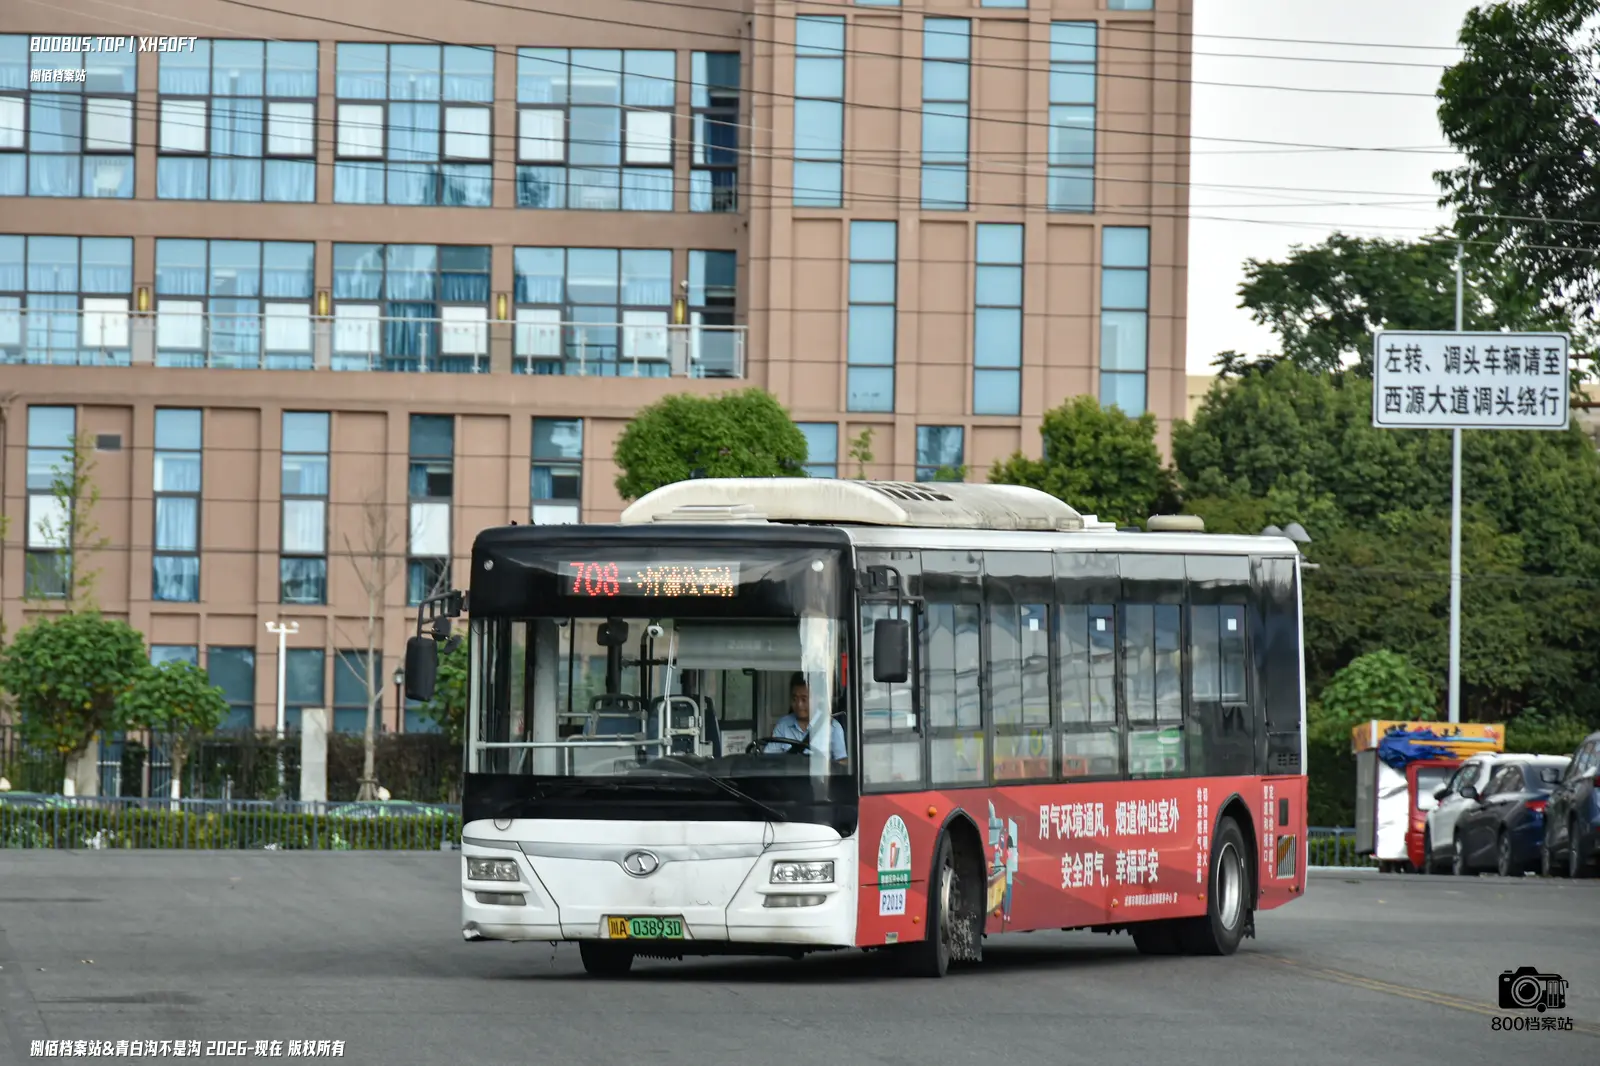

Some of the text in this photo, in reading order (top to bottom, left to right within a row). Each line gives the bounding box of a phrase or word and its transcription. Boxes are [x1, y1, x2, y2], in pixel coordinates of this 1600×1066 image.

[1384, 343, 1561, 376] 左转、调头车辆请至
[1384, 384, 1561, 416] 西源大道调头绕行
[569, 561, 620, 596] 708
[881, 894, 904, 911] P2019
